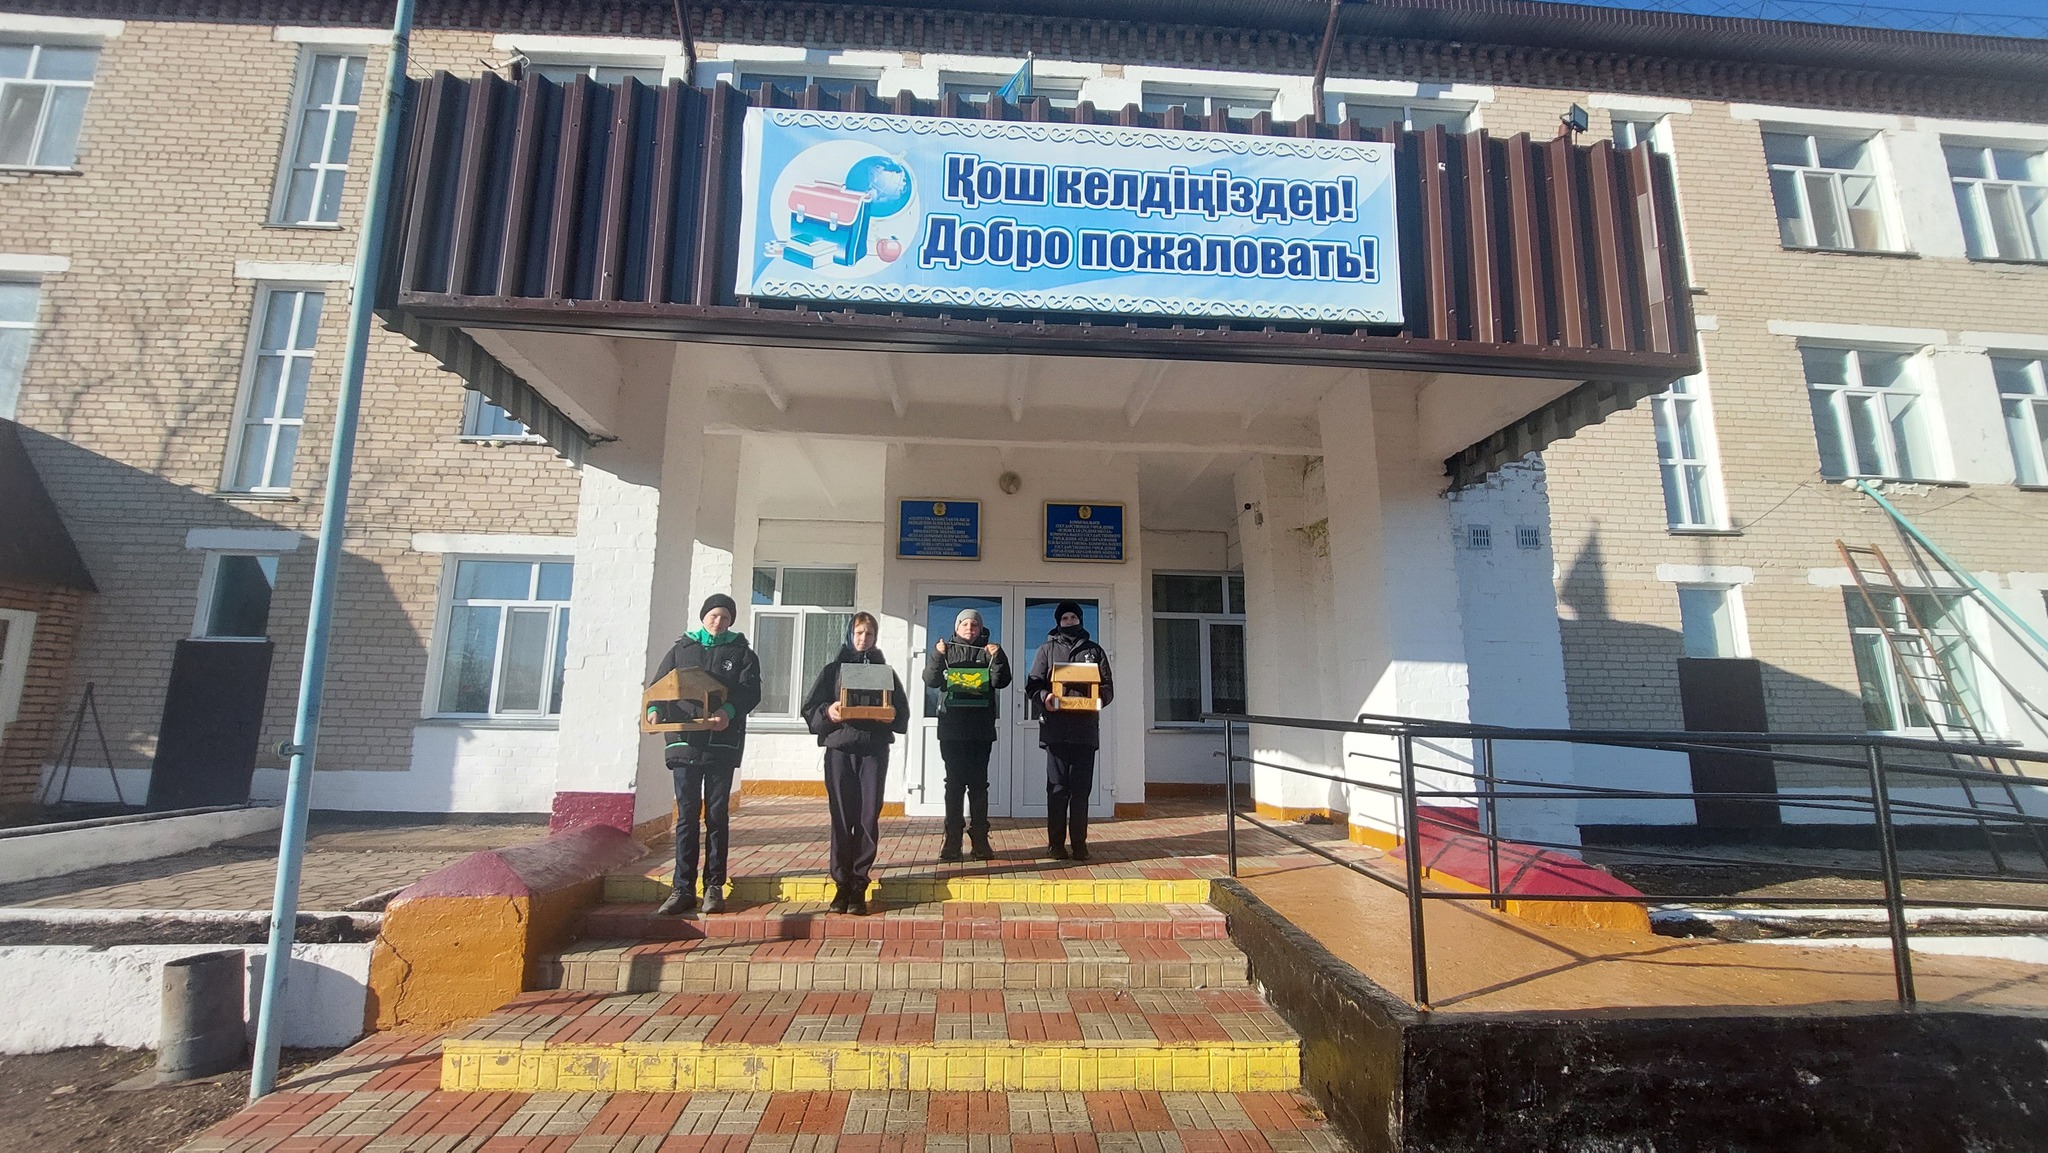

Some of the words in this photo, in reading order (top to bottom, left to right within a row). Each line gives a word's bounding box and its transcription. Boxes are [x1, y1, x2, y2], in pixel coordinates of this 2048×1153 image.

[946, 155, 1046, 206] Қош
[1055, 168, 1356, 223] келдіңіздер!
[921, 216, 1071, 269] Добро
[1080, 231, 1377, 281] пожаловать!
